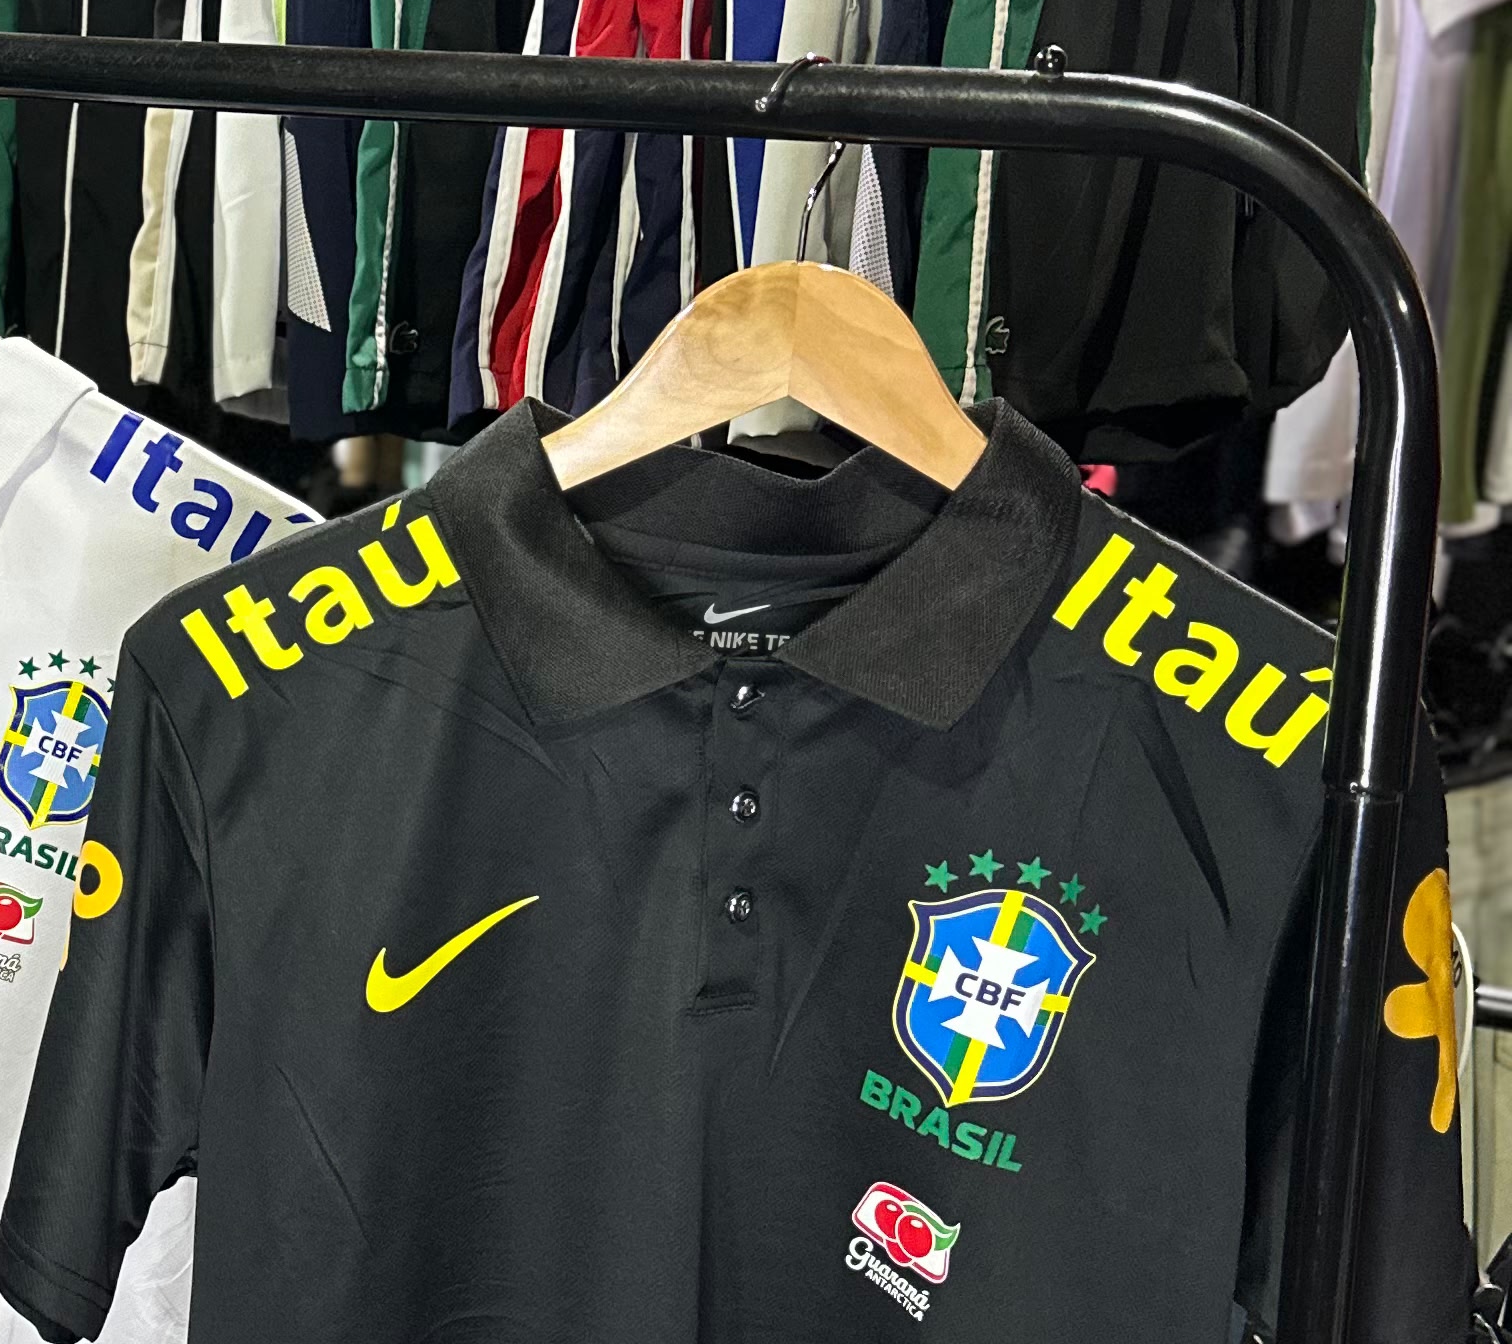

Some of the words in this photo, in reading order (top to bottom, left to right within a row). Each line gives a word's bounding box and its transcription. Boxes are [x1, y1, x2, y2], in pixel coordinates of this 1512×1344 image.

[180, 499, 461, 699] Itaú
[710, 631, 759, 650] NIKE
[1052, 532, 1334, 768] Itaú
[38, 735, 83, 764] CBF
[954, 972, 1026, 1012] CBF
[860, 1069, 1023, 1172] BRASIL
[845, 1236, 931, 1311] Guaraná
[864, 1269, 925, 1322] ANTARCTICA
